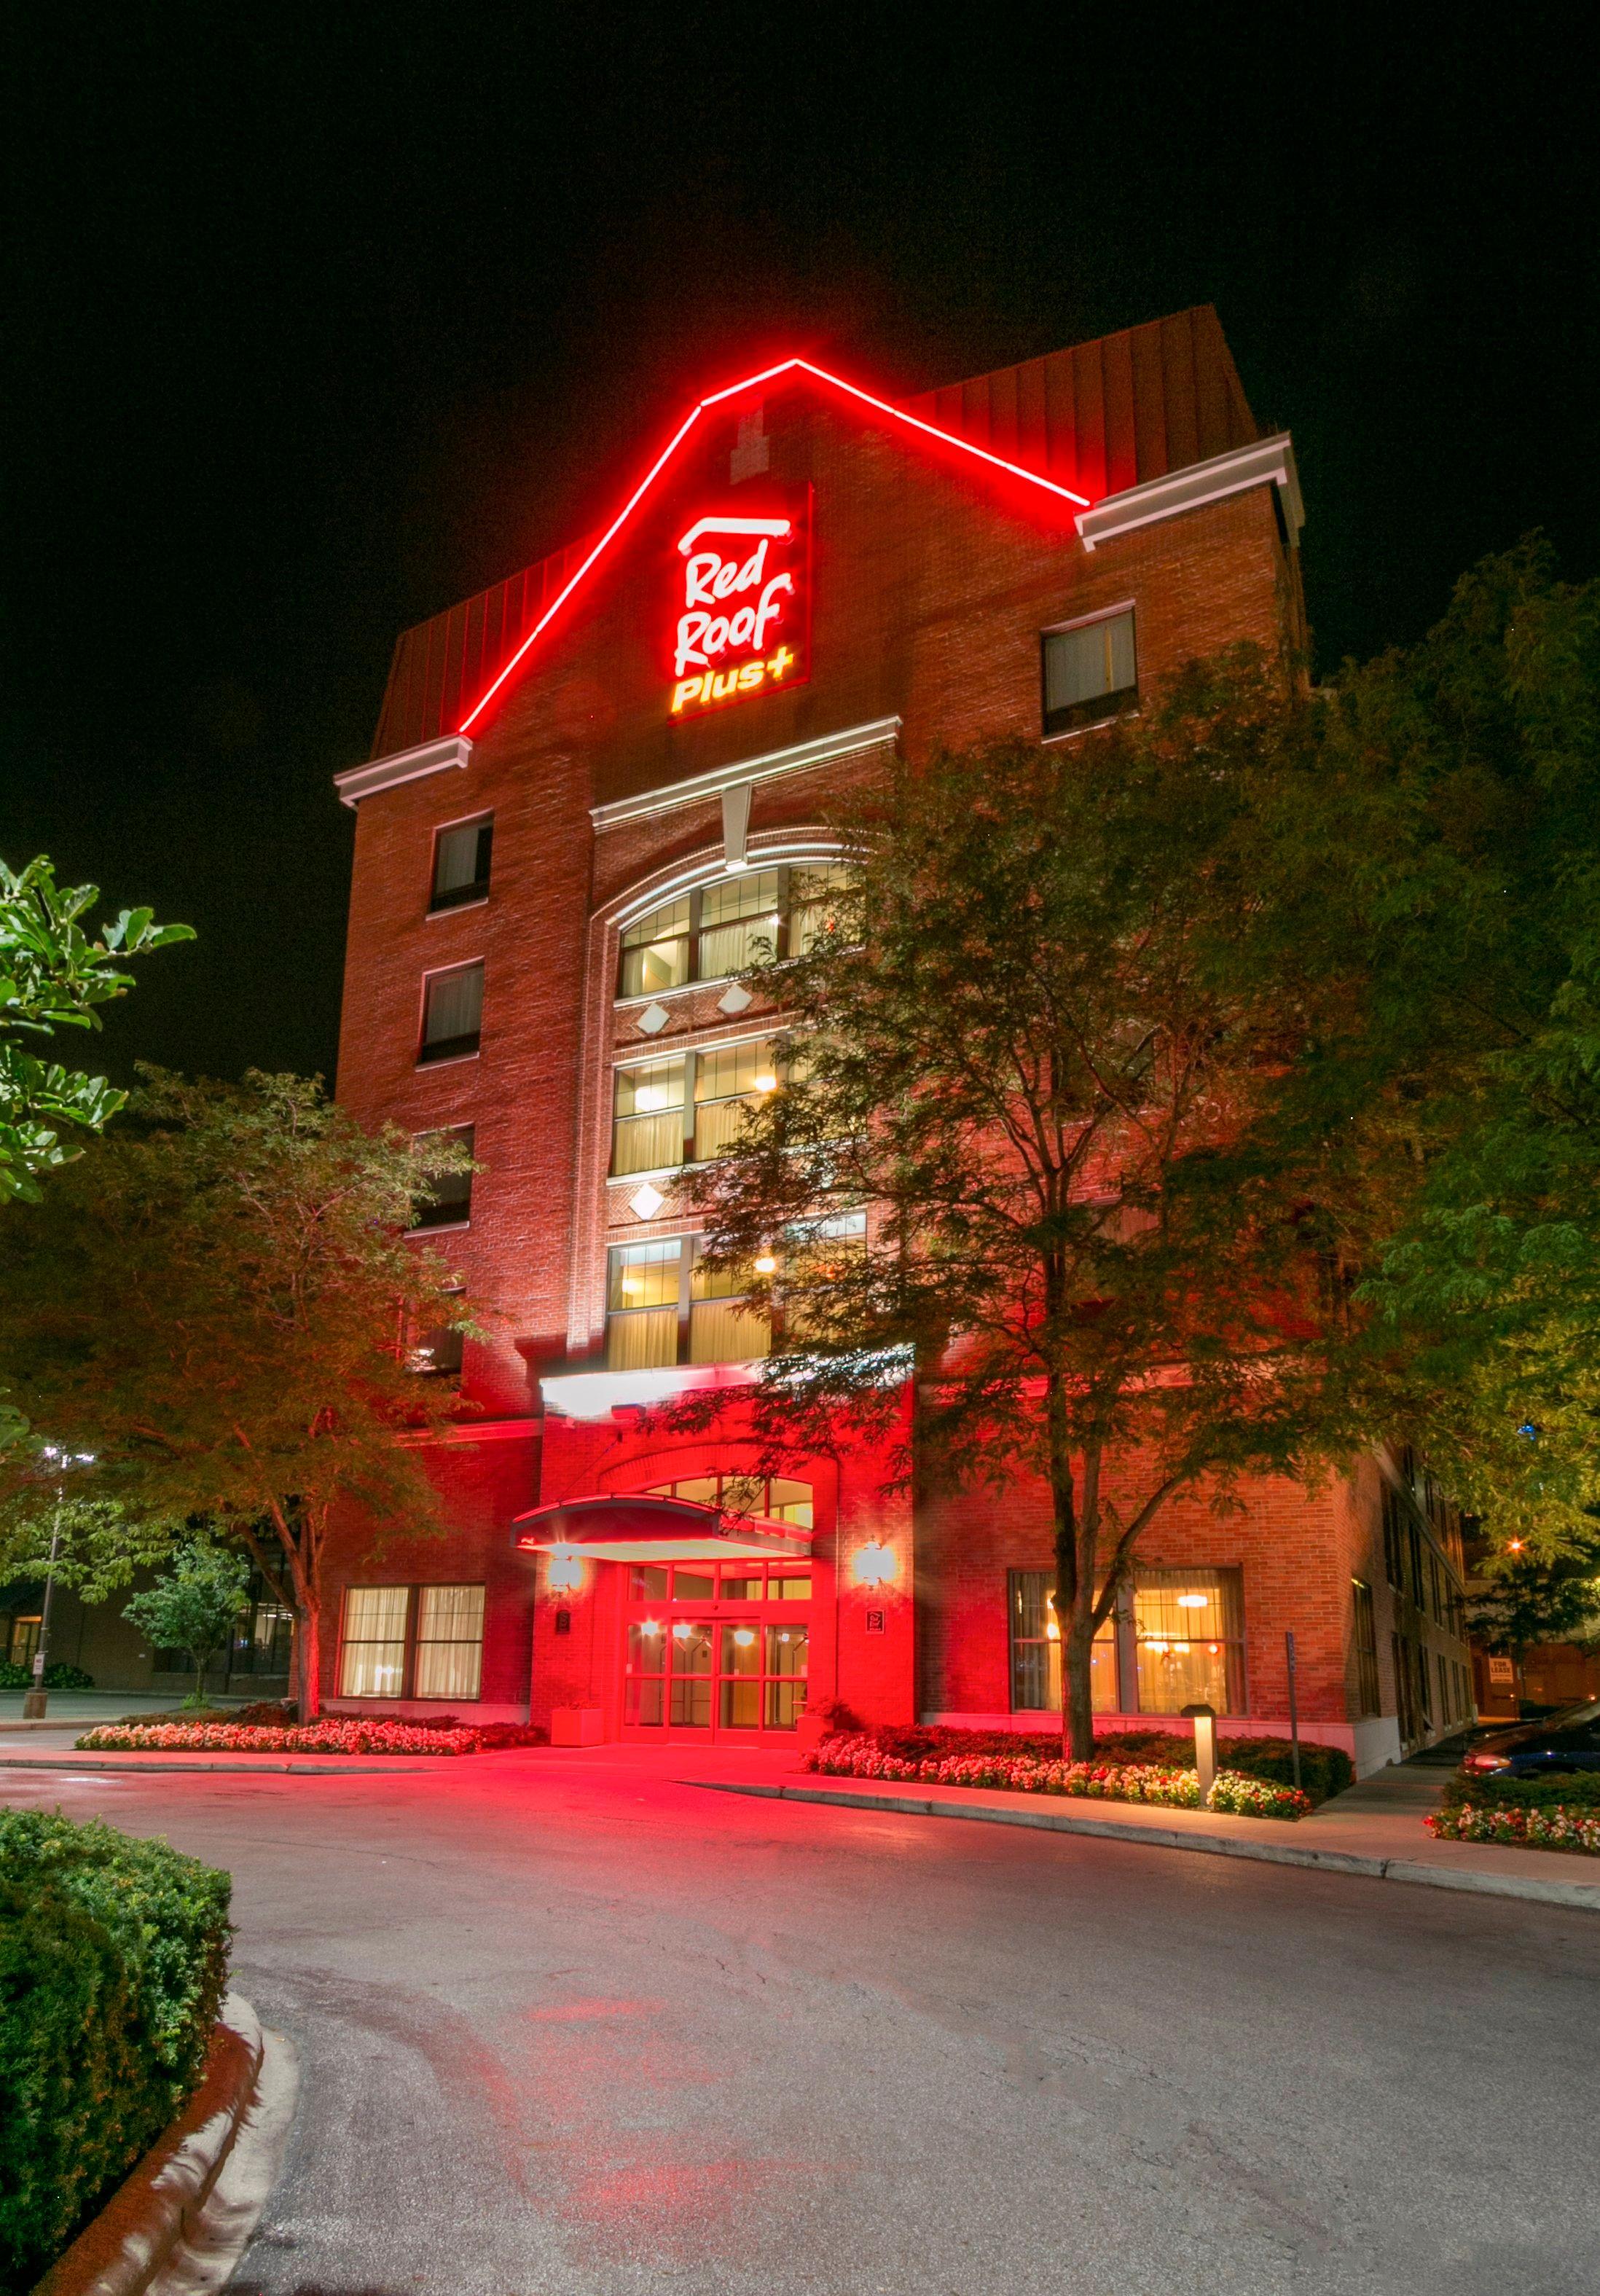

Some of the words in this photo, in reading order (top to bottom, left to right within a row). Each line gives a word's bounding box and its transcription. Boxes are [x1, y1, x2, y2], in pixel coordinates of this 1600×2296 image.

[686, 538, 769, 608] Red
[674, 573, 792, 678] Roof
[671, 646, 794, 713] Plus+
